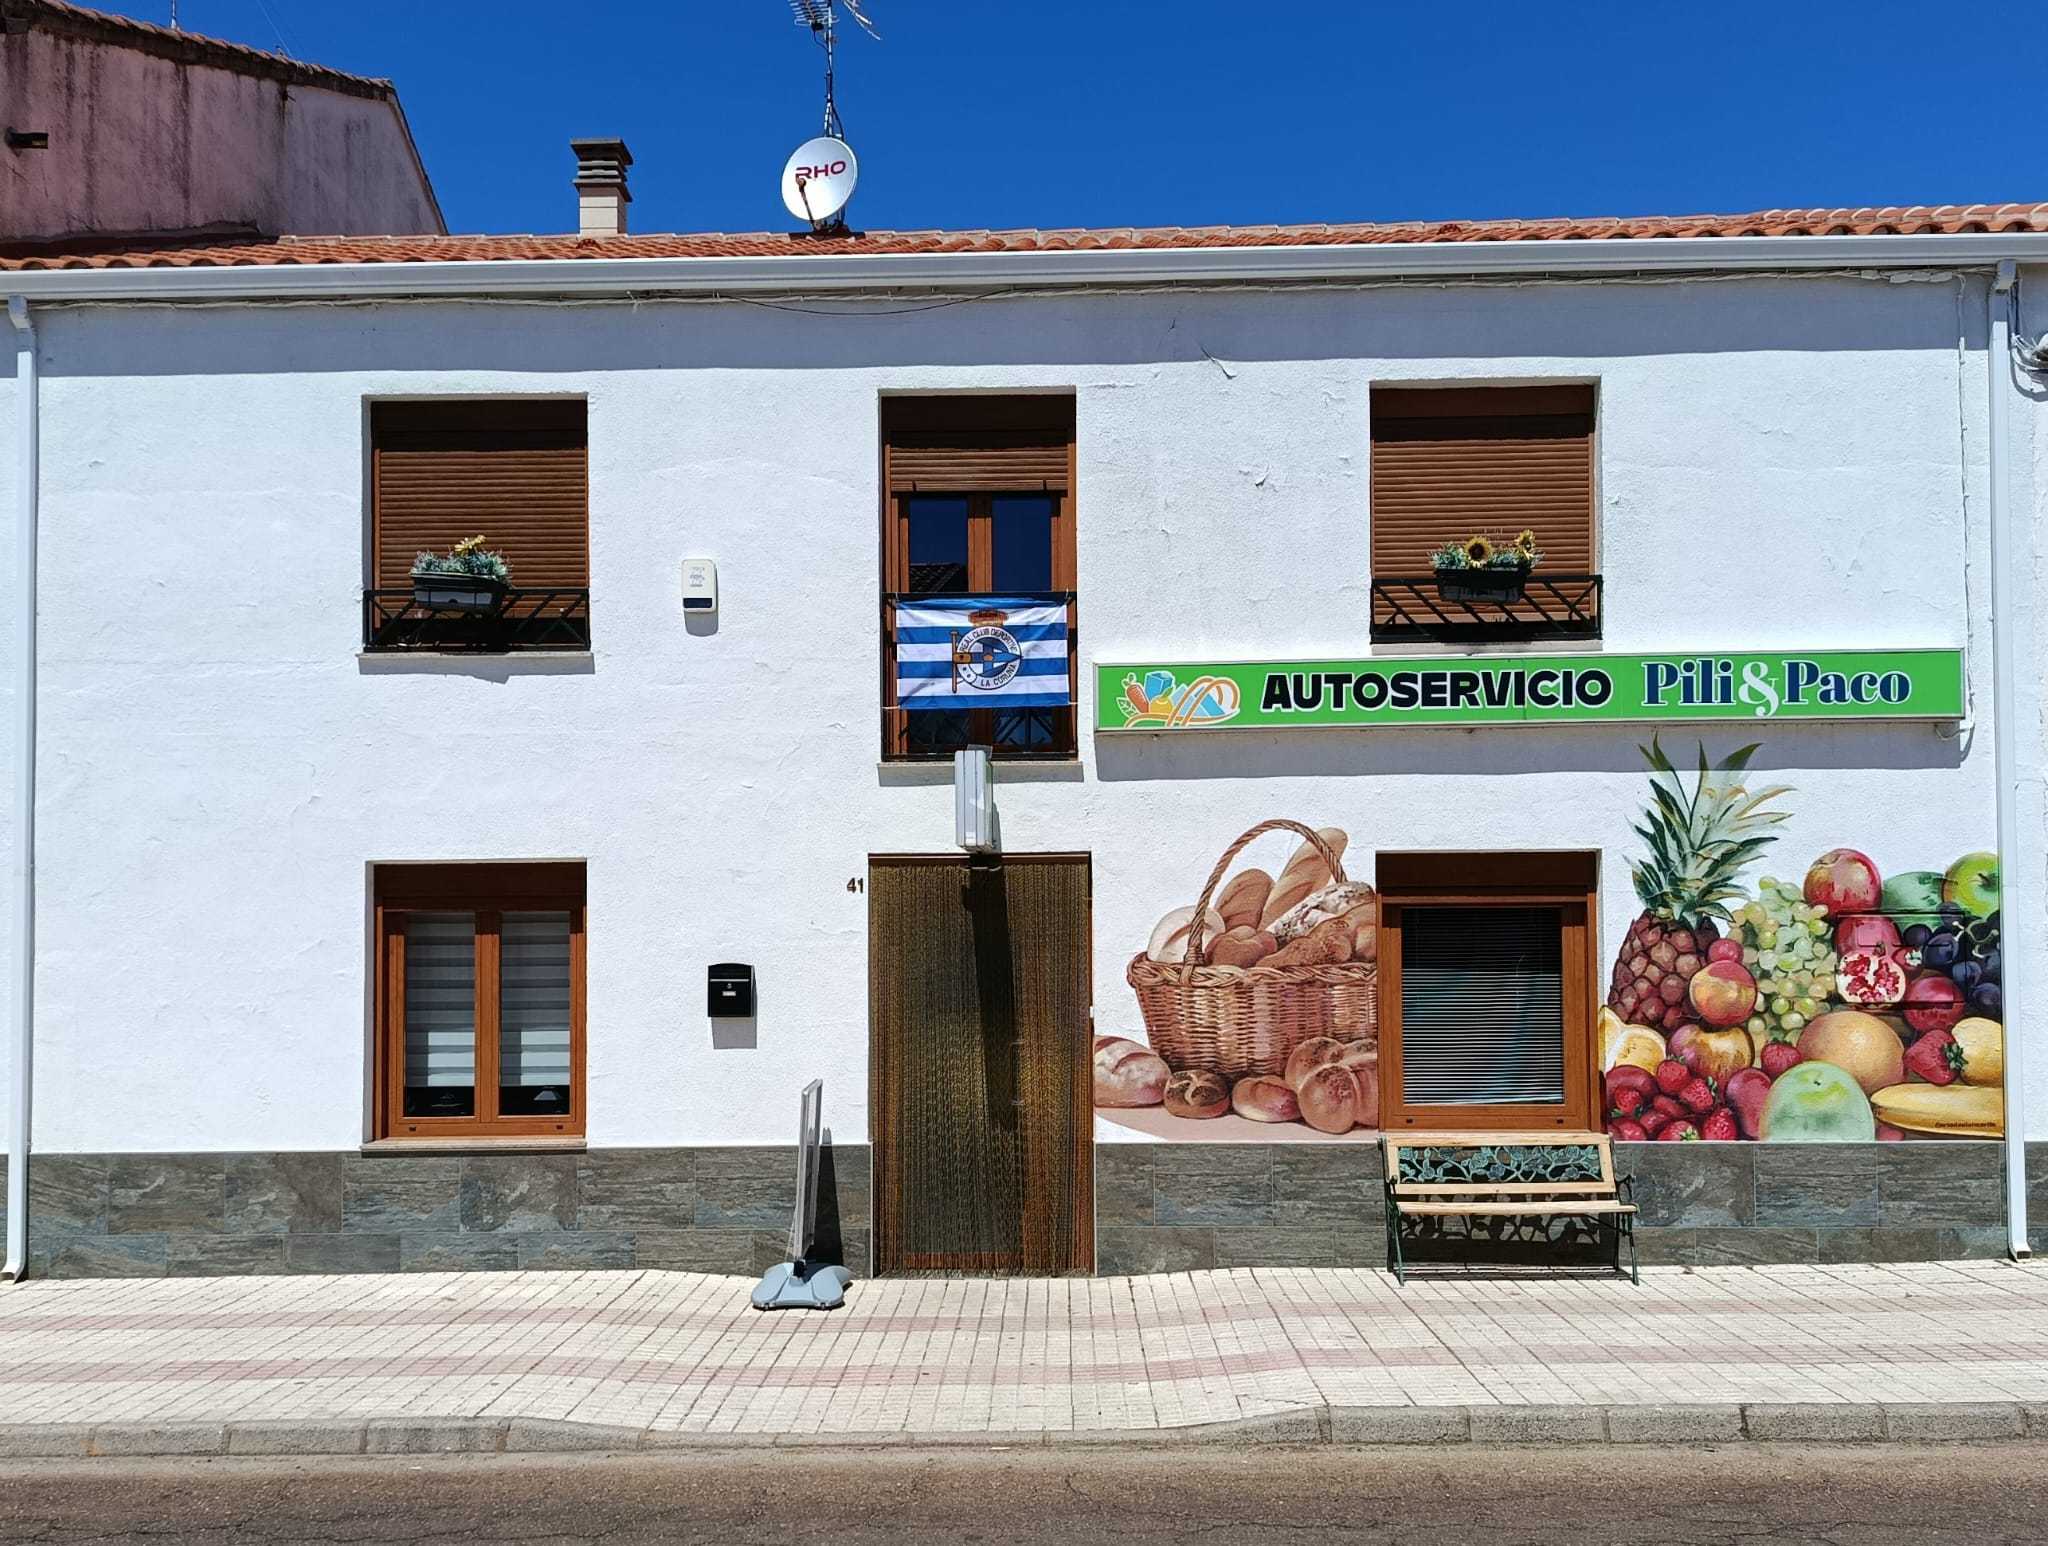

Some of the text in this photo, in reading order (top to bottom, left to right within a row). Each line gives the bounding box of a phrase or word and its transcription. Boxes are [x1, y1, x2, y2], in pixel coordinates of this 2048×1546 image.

[796, 161, 846, 180] RHO
[960, 633, 975, 651] REAL
[981, 679, 991, 687] LA
[1261, 669, 1613, 711] AUTOSERVICIO
[847, 877, 863, 893] 41
